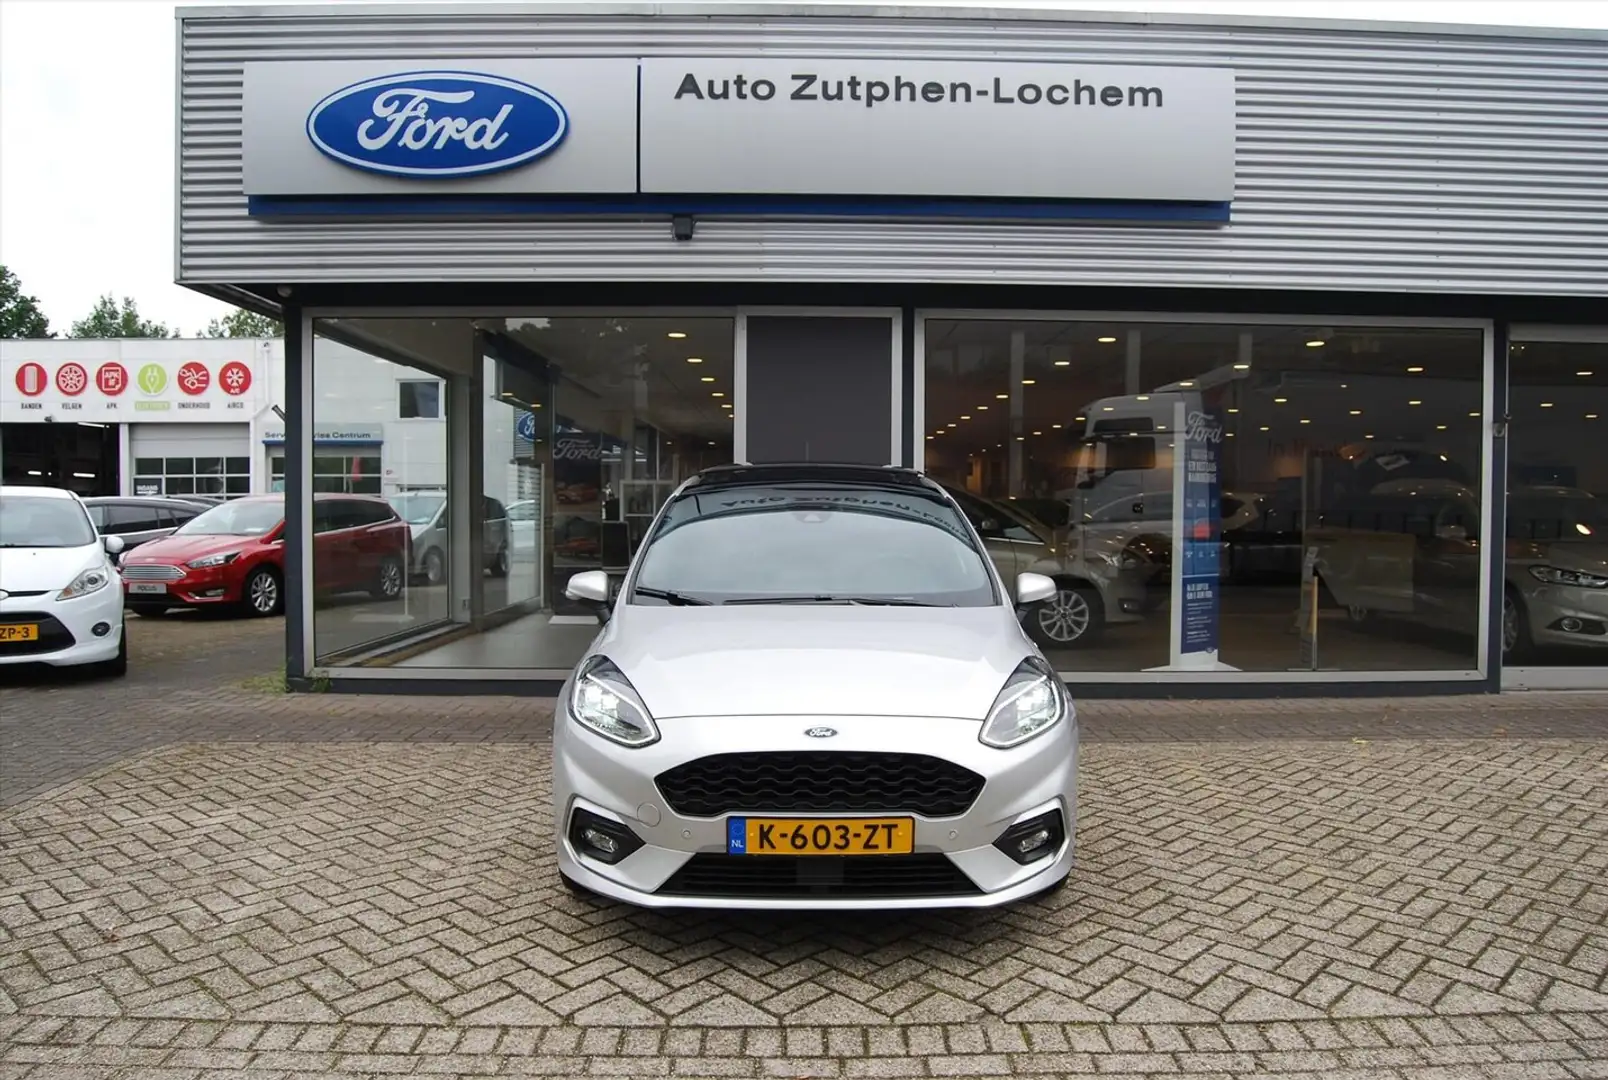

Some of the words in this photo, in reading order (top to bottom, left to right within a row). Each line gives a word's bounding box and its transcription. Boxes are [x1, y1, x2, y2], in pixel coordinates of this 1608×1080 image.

[674, 73, 777, 101] Auto
[789, 73, 1164, 108] Zutphen-Lochem
[356, 87, 514, 151] Ford
[61, 402, 83, 410] VELGEN
[106, 402, 118, 410] APK
[177, 402, 211, 410] ONDERHOUD
[226, 402, 244, 410] AIRCO
[1184, 410, 1223, 444] Ford
[332, 431, 371, 439] Centrum
[553, 437, 602, 460] Ford
[808, 726, 834, 738] Ford
[731, 839, 744, 849] NL
[758, 823, 899, 851] K-603-ZT
